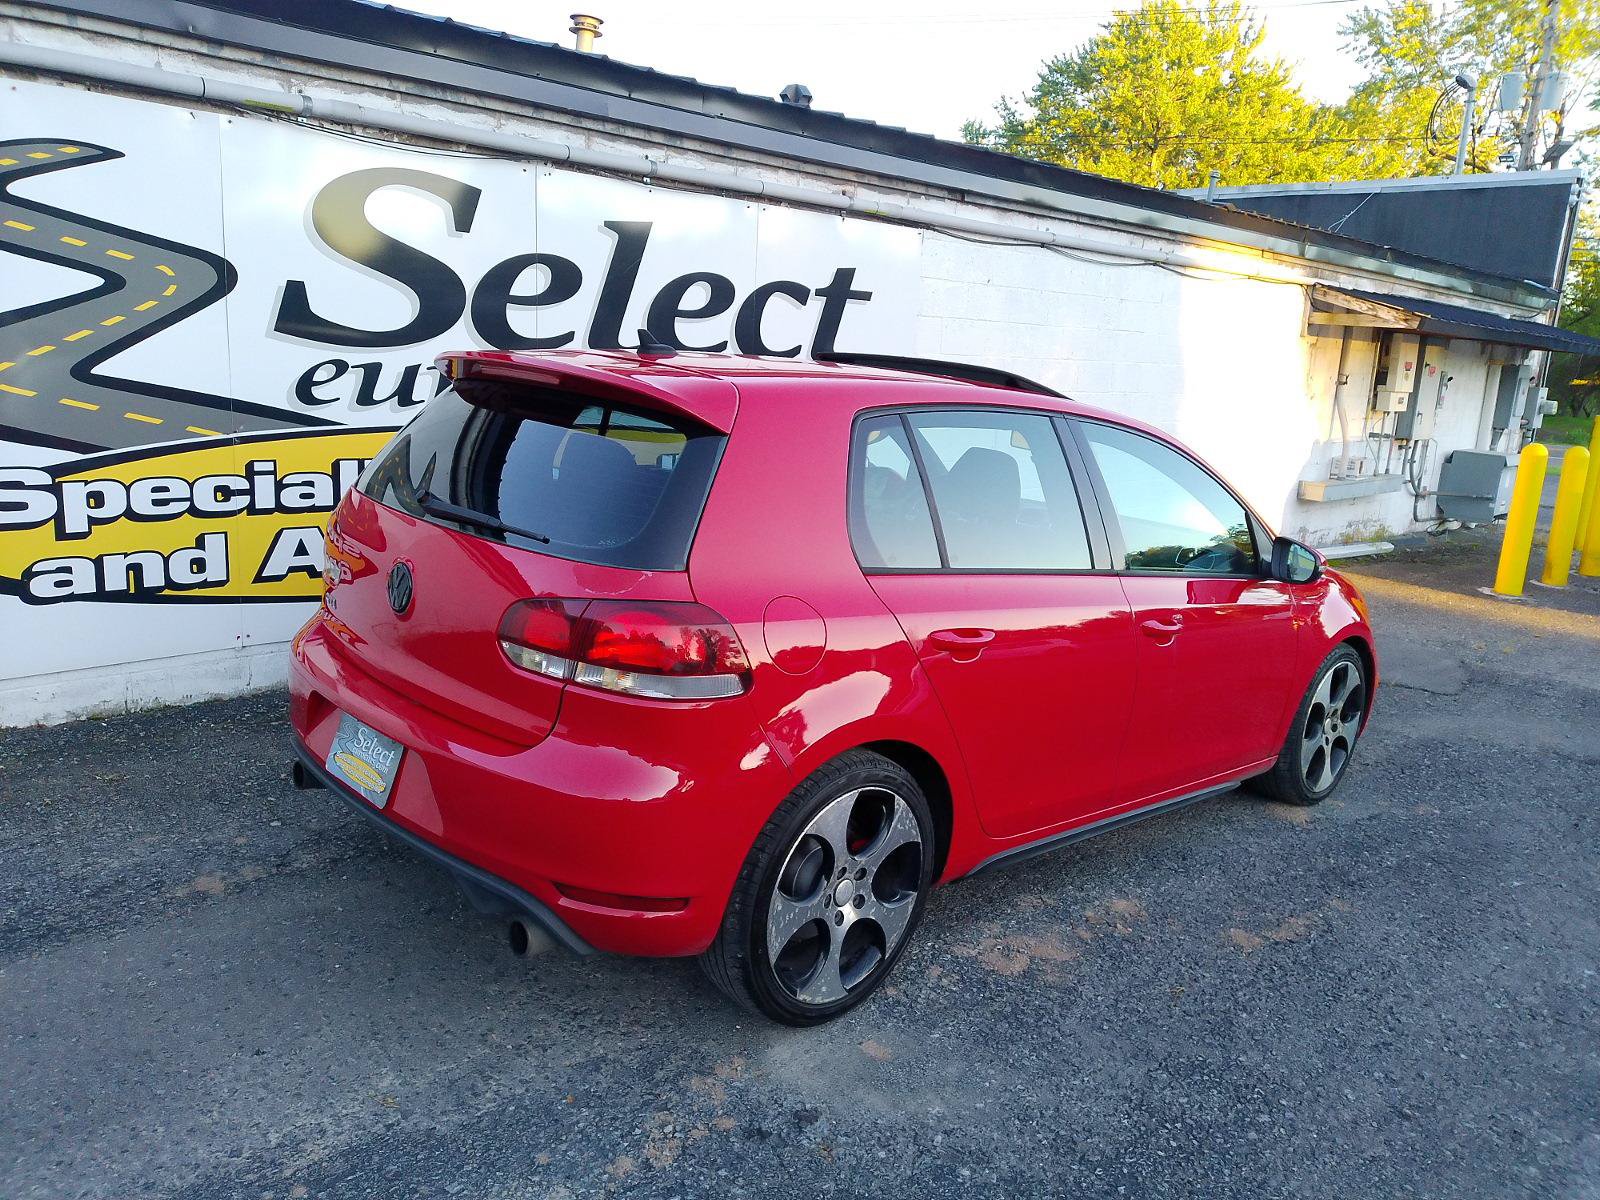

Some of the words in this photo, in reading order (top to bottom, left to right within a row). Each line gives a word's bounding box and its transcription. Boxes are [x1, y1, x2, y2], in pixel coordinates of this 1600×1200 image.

[273, 166, 873, 361] Select
[0, 459, 374, 535] Special
[28, 532, 229, 599] and
[354, 727, 395, 767] Select
